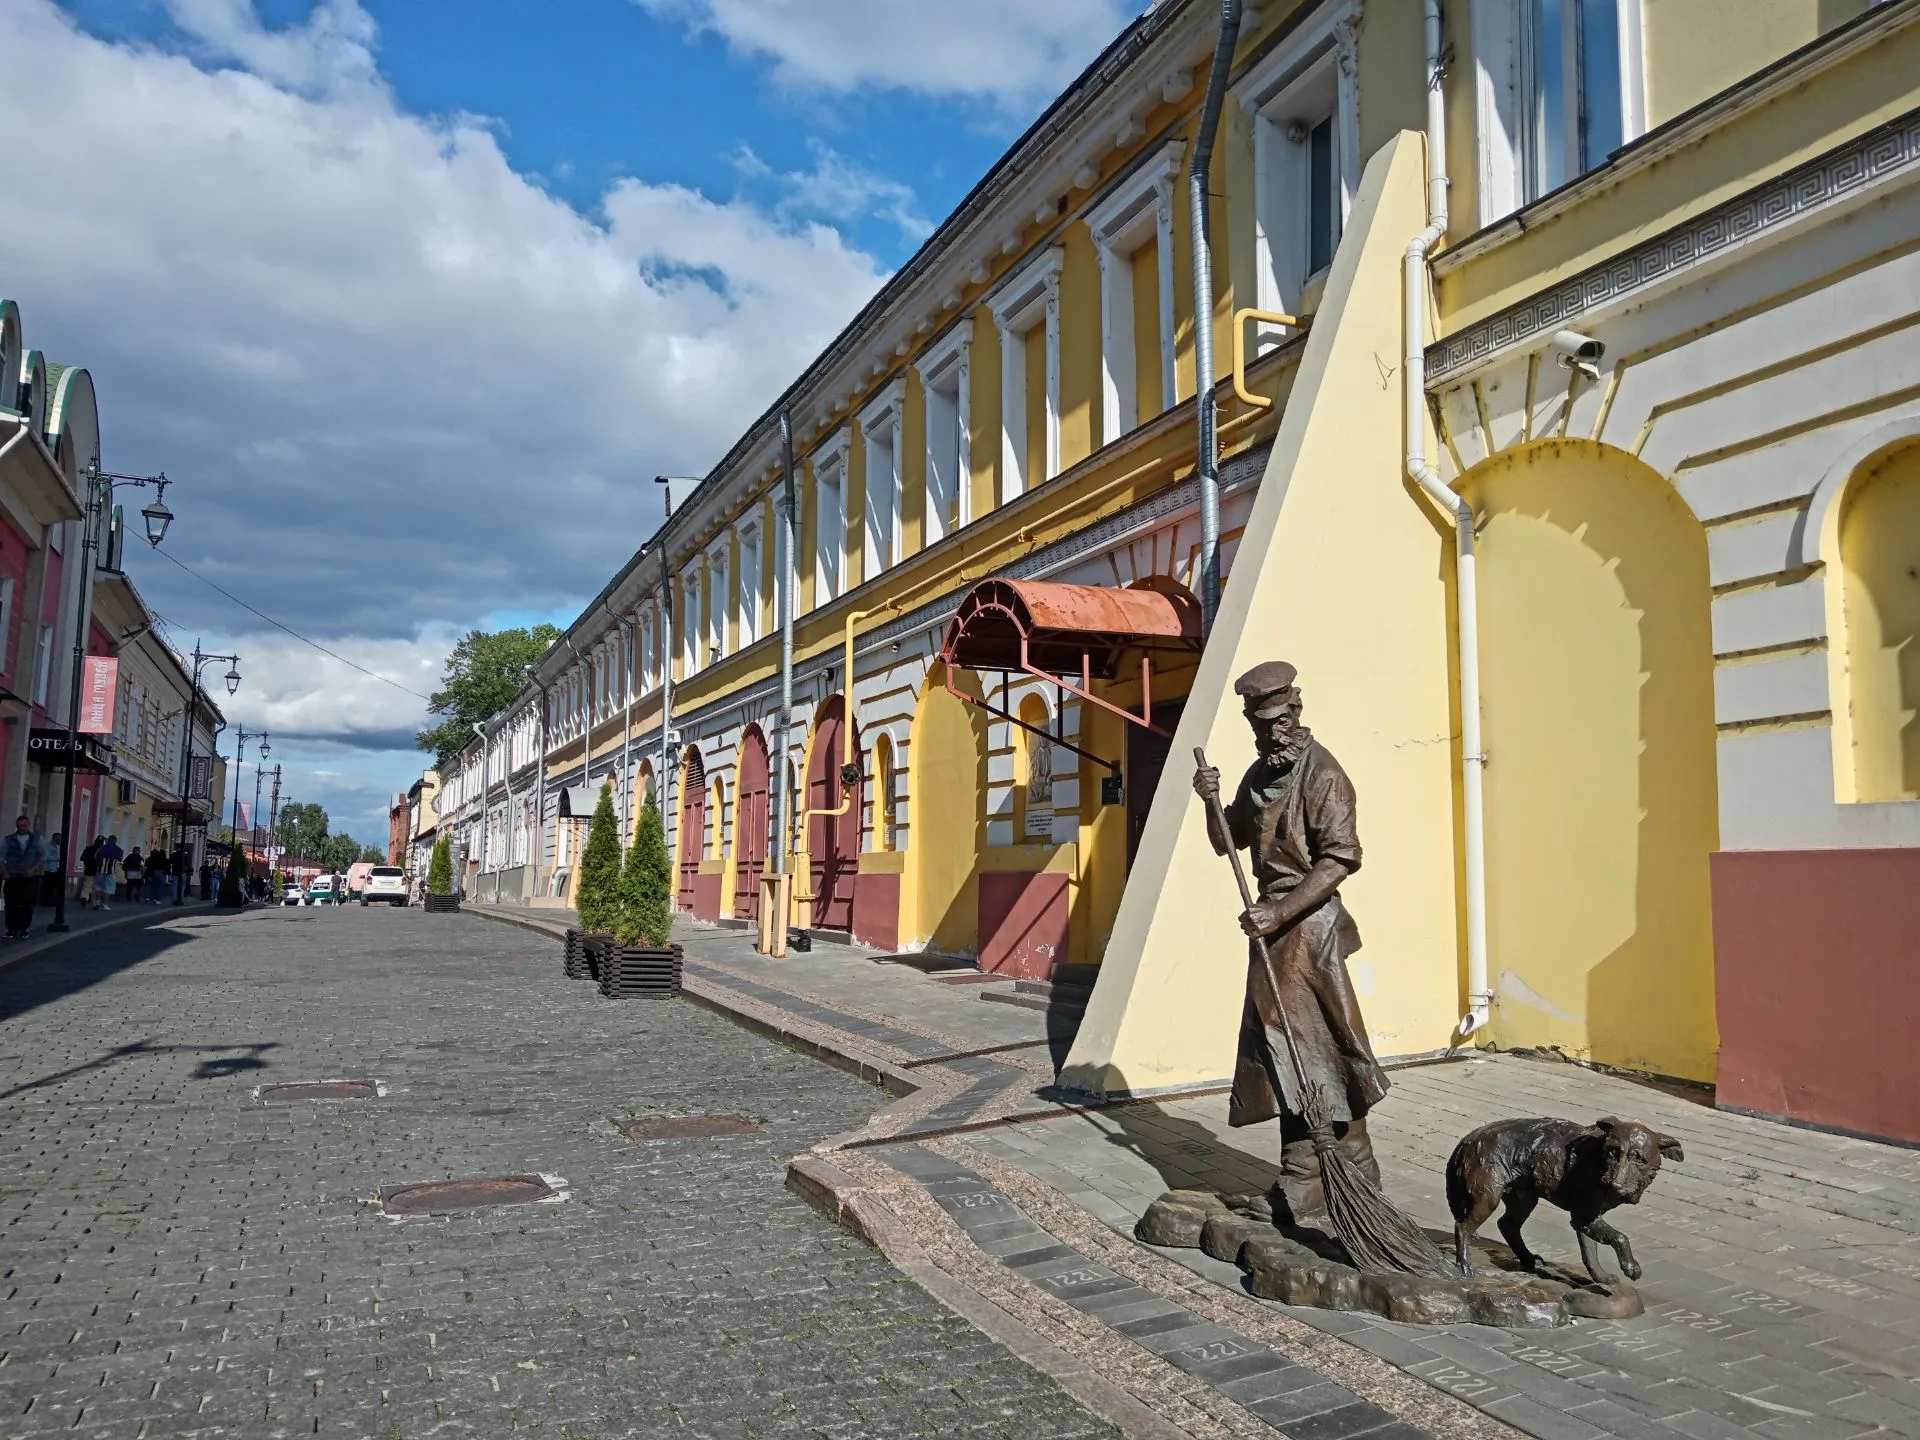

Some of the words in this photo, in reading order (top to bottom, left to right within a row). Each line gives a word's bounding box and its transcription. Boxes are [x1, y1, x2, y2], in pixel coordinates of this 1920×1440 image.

[1045, 1269, 1103, 1287] 1221
[1731, 1290, 1802, 1314] 1221
[1661, 1308, 1732, 1333] 1221
[1586, 1326, 1658, 1352] 1221
[1510, 1346, 1582, 1374] 1221
[1425, 1366, 1497, 1397] 1221
